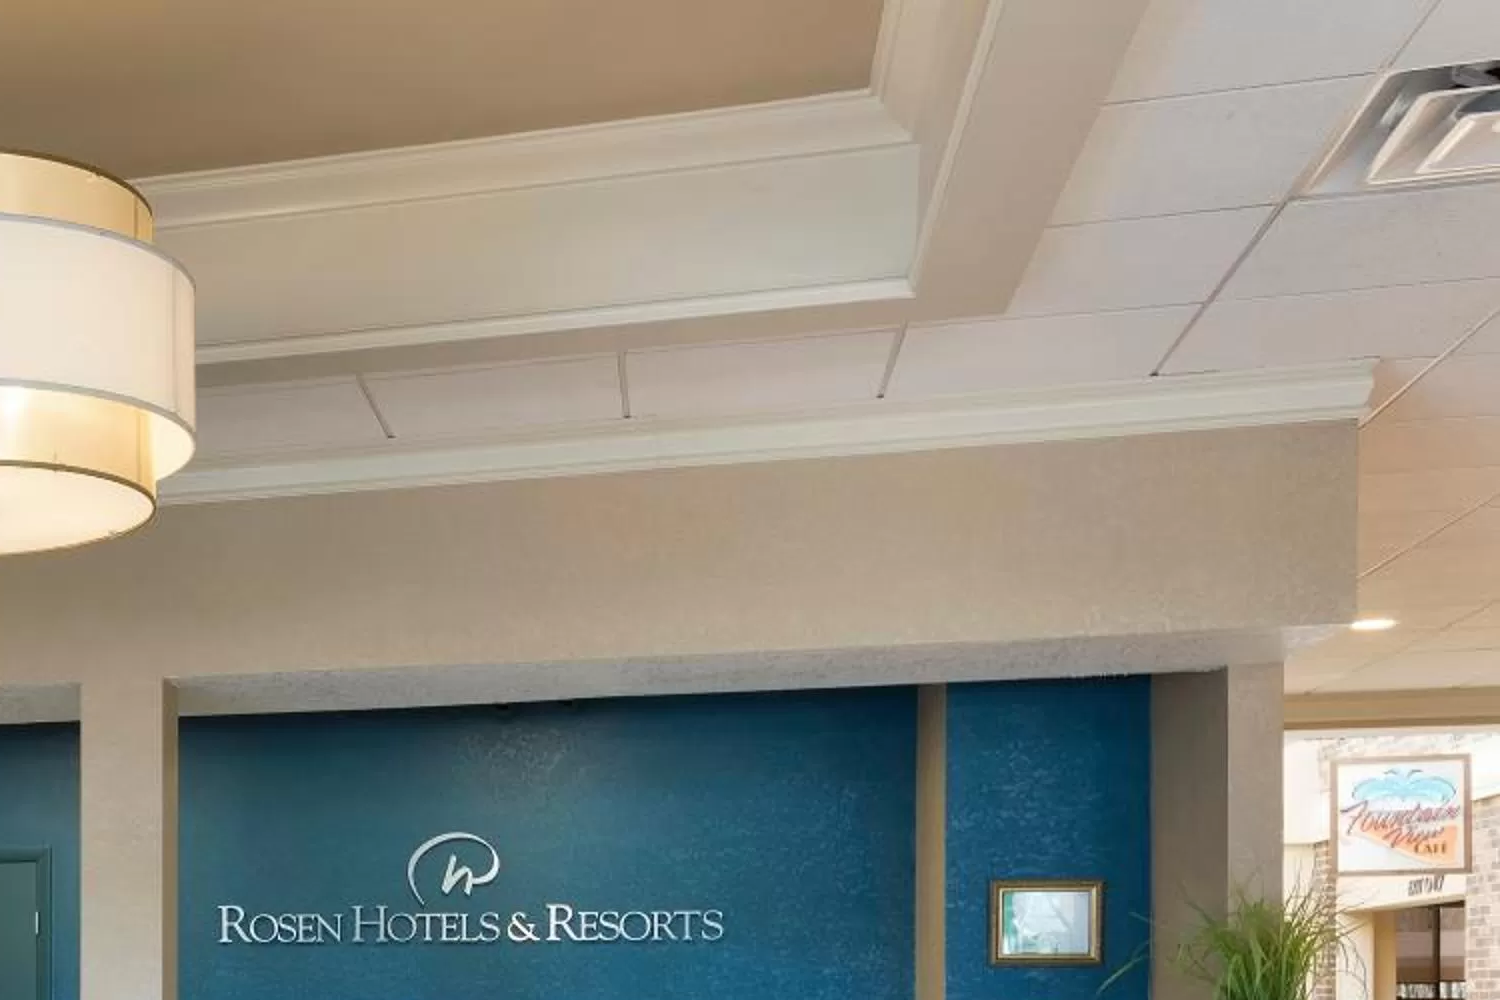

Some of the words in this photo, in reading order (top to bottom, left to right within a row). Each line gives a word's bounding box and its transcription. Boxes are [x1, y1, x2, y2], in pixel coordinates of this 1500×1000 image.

[217, 904, 343, 943] ROSEN
[351, 904, 500, 943] HOTELS
[507, 911, 540, 942] &
[545, 903, 724, 941] RESORTS
